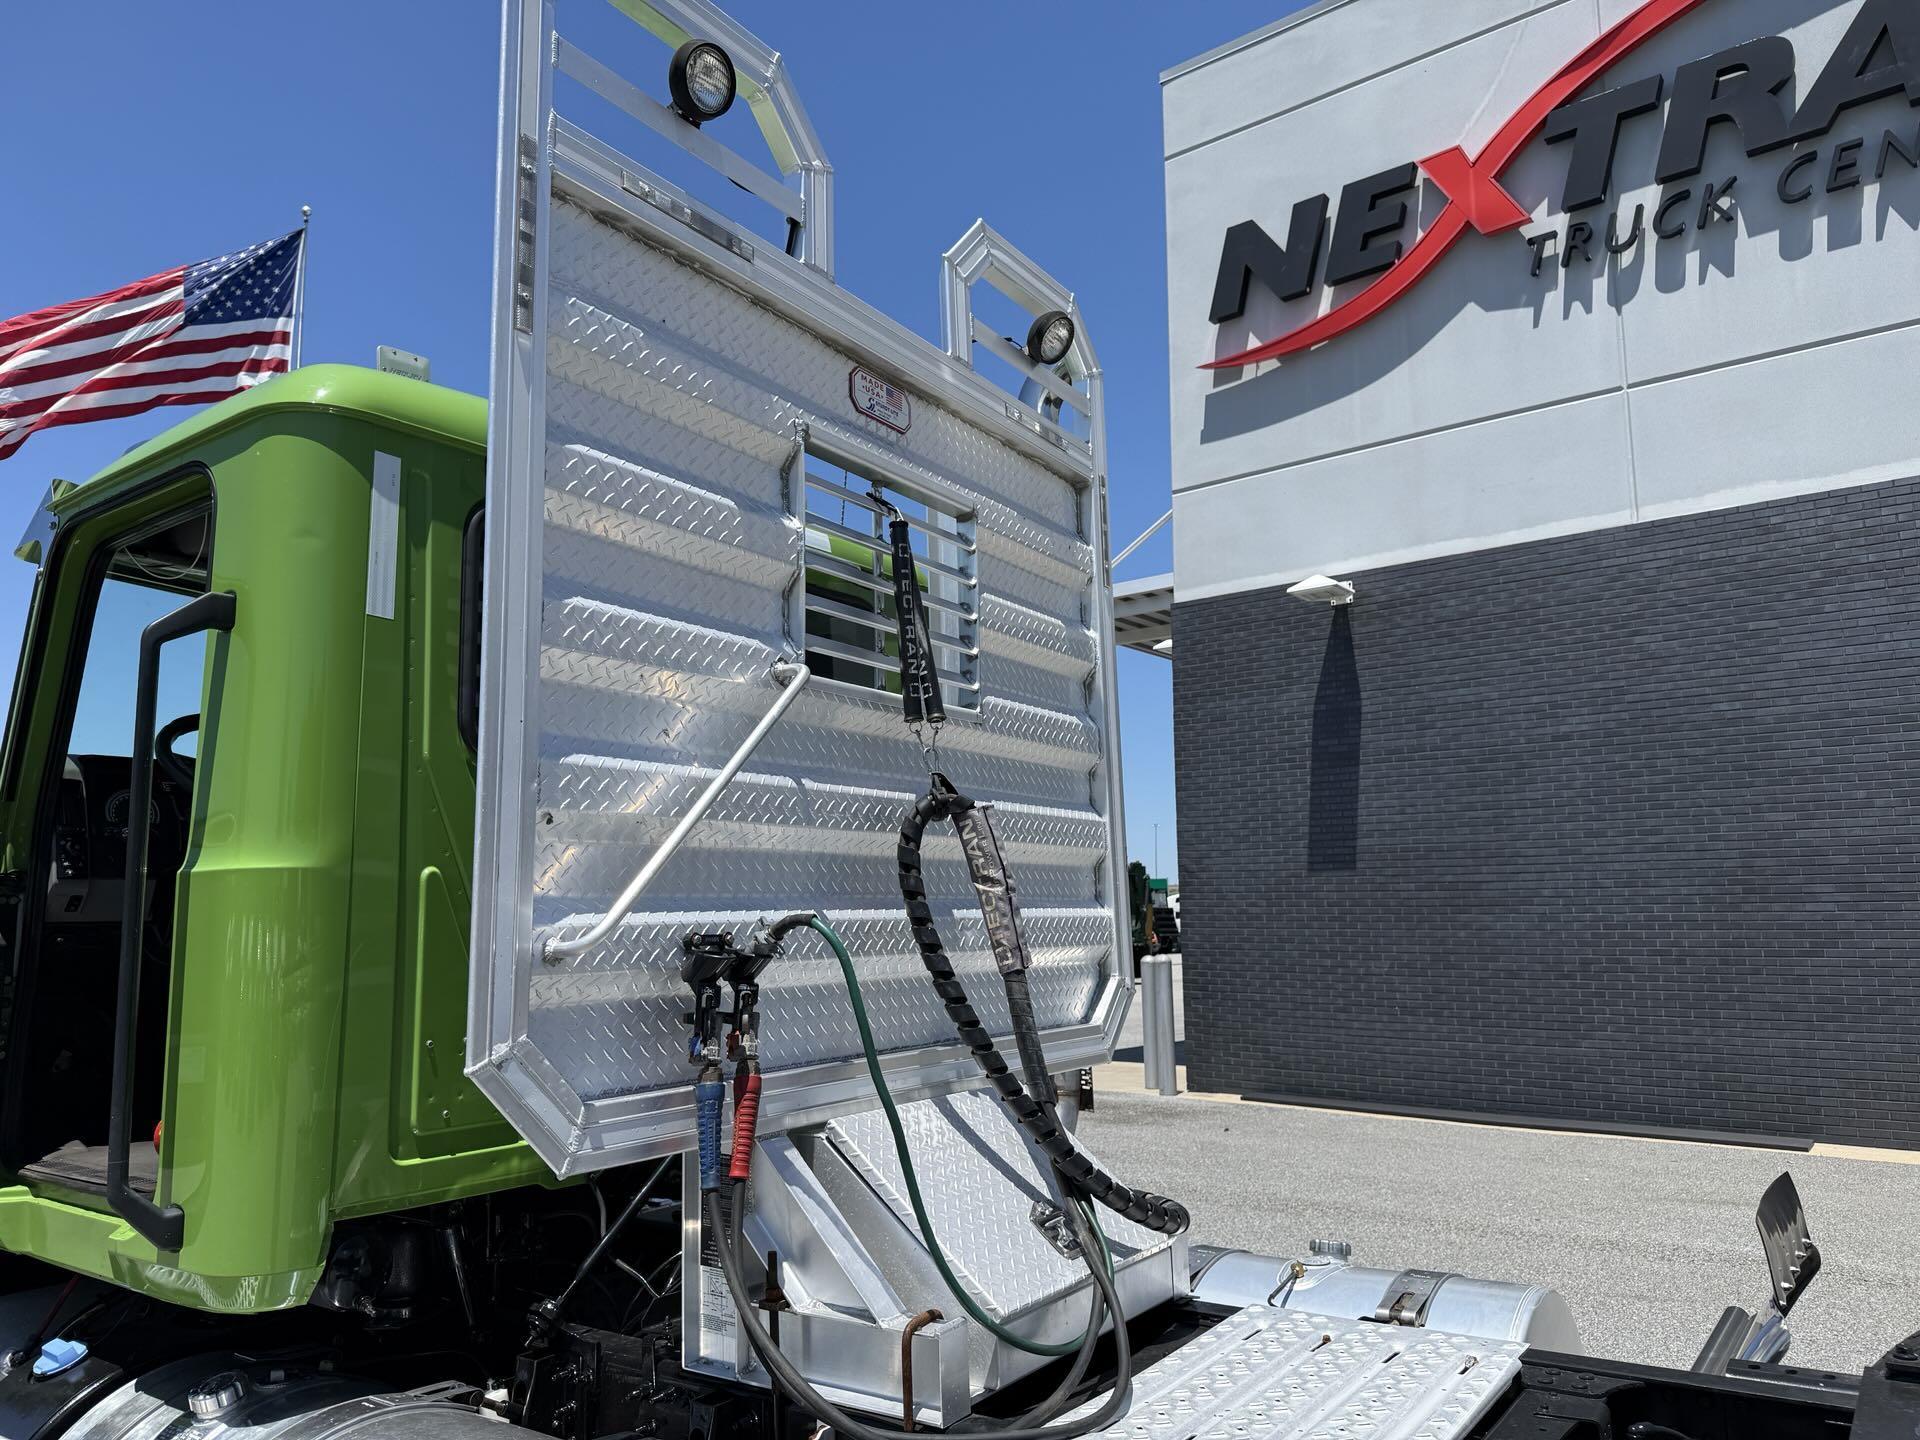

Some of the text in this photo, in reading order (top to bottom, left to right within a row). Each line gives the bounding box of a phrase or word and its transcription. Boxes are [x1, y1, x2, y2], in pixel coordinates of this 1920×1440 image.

[1208, 0, 1920, 326] NEXTRA
[1526, 121, 1920, 277] TRUCK CEN
[861, 373, 884, 392] MADE
